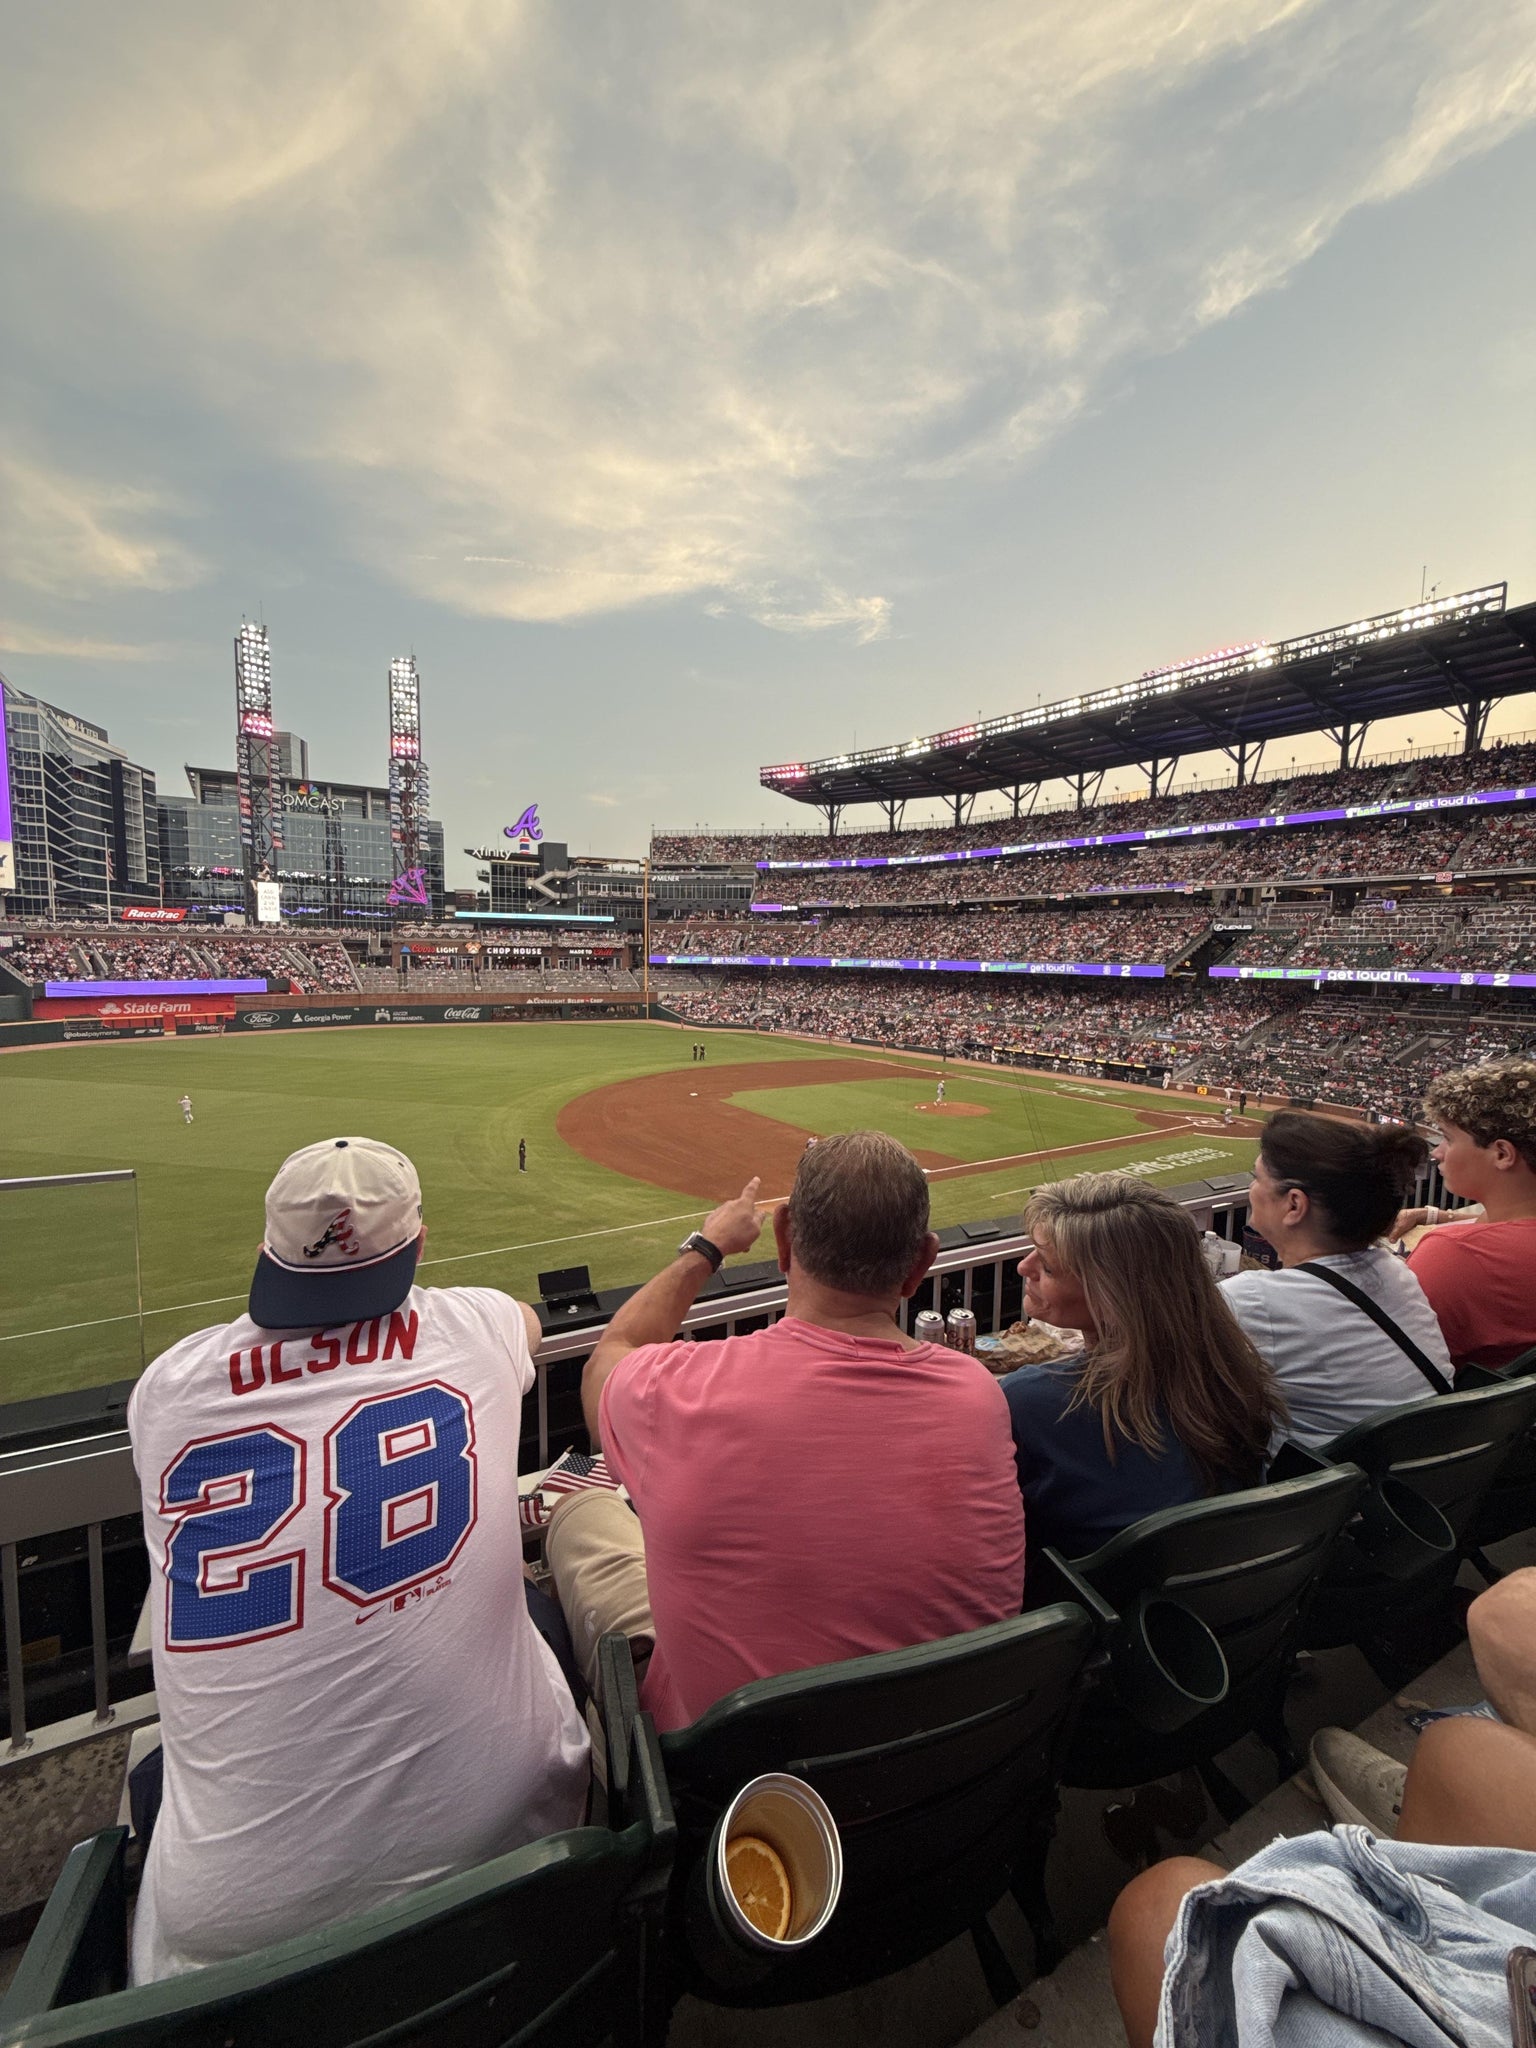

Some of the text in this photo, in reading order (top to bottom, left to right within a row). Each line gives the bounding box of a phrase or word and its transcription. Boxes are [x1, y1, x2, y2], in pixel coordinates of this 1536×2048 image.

[282, 793, 348, 811] OMCAST
[1415, 799, 1435, 810] get
[1437, 796, 1464, 807] loud
[503, 803, 543, 840] A
[1275, 816, 1285, 826] 2
[1192, 825, 1206, 835] get
[1207, 823, 1225, 833] loud
[472, 845, 513, 860] xfinity
[128, 909, 180, 919] RaceTrac
[436, 946, 459, 954] LIGHT
[486, 947, 542, 955] CHOP HOUSE
[711, 957, 724, 965] get
[782, 957, 790, 966] 2
[929, 960, 937, 970] 2
[1030, 964, 1045, 974] get
[1046, 963, 1066, 973] loud
[1120, 965, 1131, 977] 2
[1327, 970, 1354, 982] get
[1356, 970, 1391, 982] loud
[1494, 973, 1511, 987] 2
[250, 1014, 274, 1024] Ford
[304, 1012, 352, 1023] Georgia Power
[228, 1310, 420, 1397] OLSON
[159, 1379, 478, 1653] 28
